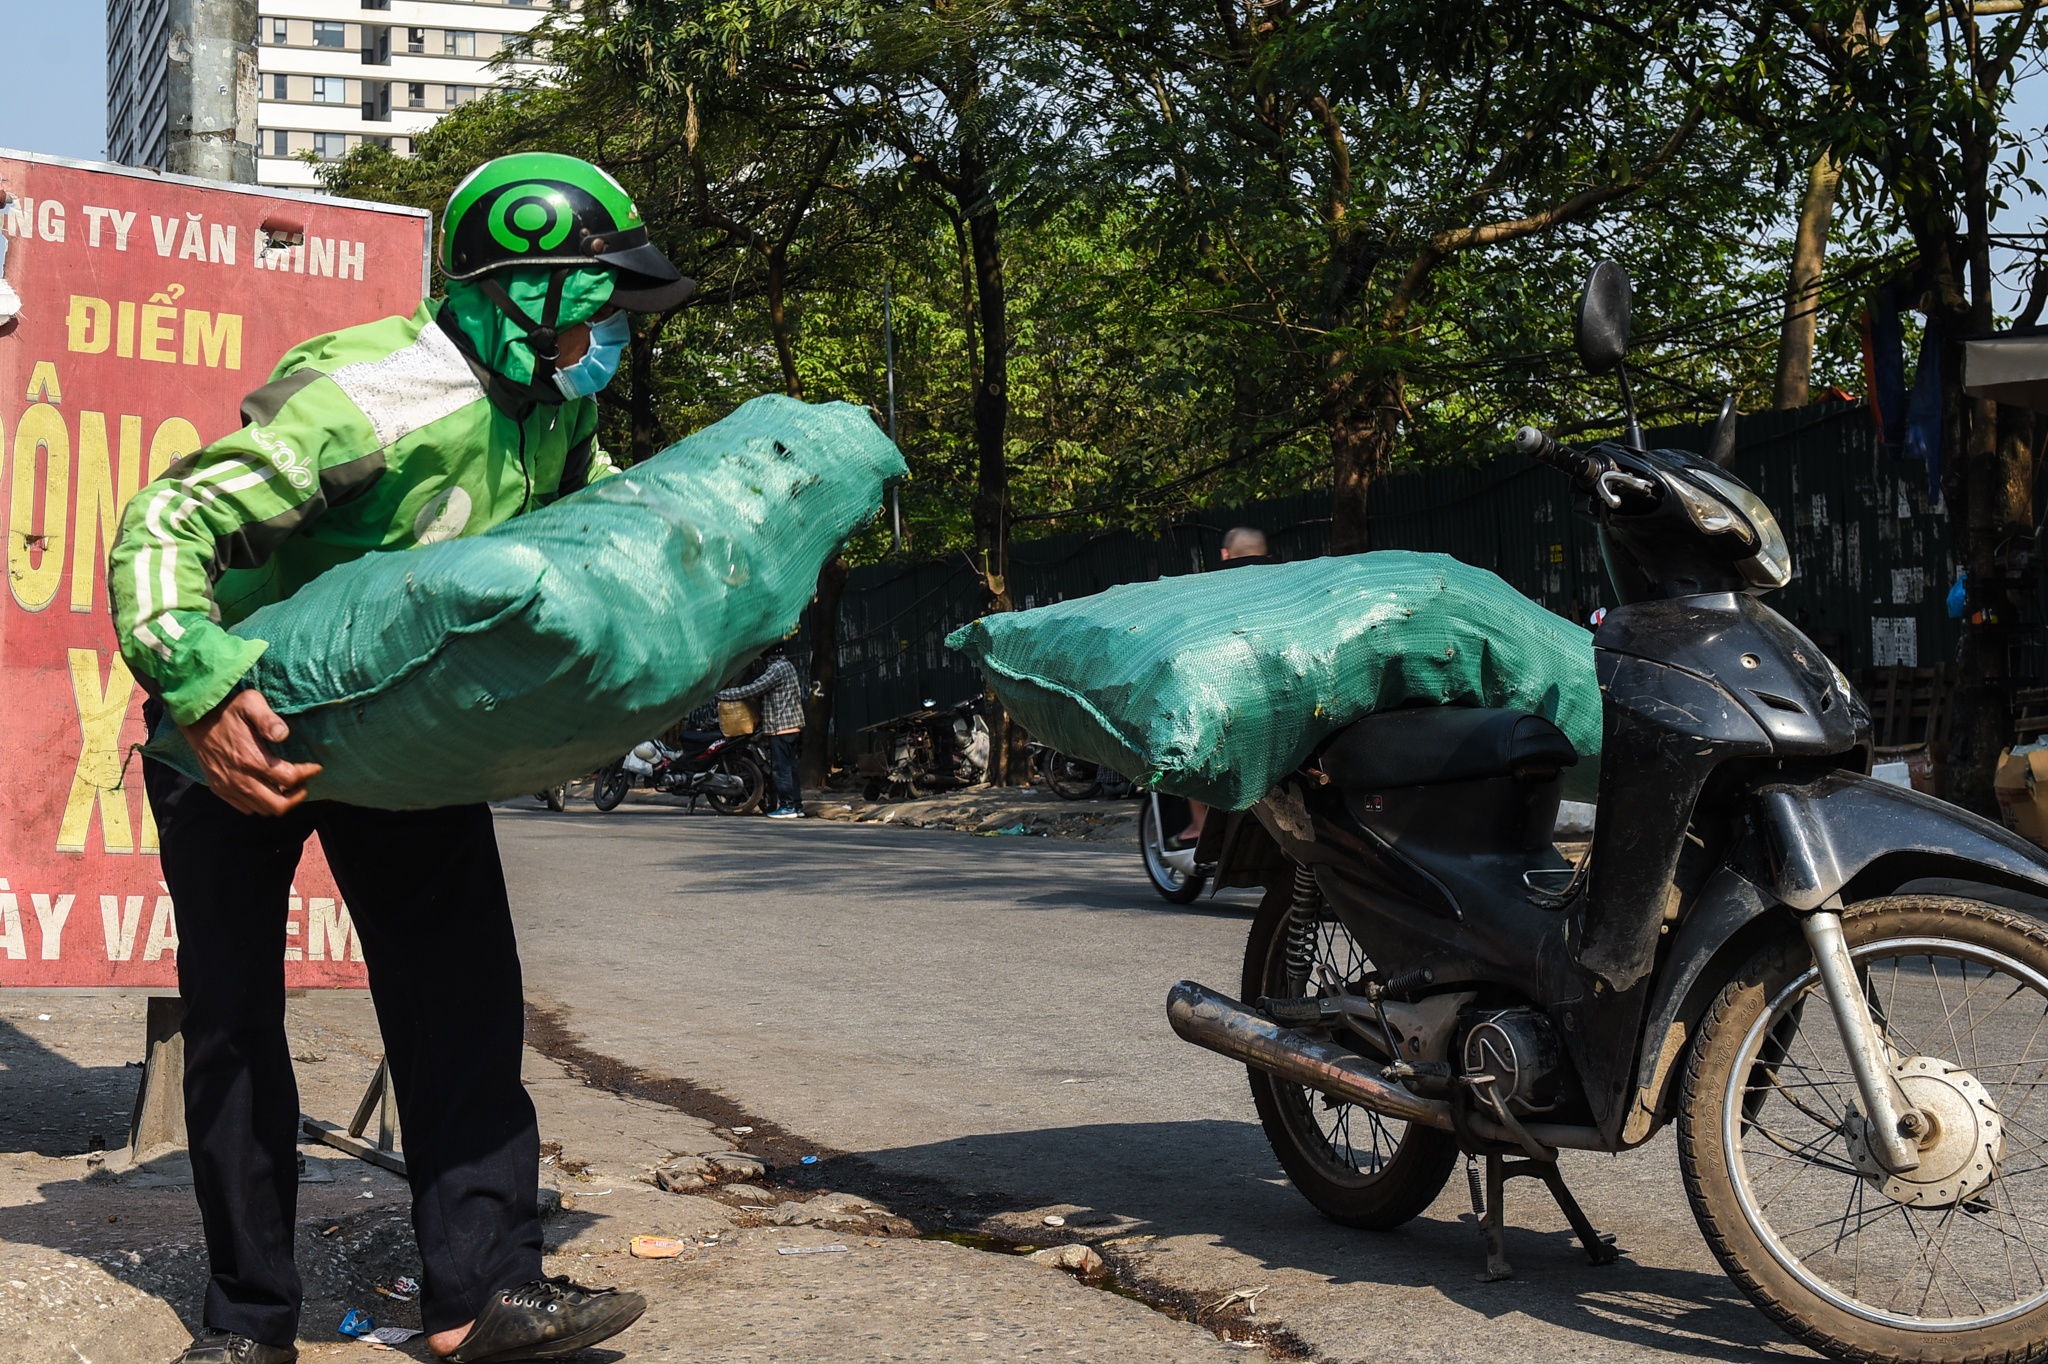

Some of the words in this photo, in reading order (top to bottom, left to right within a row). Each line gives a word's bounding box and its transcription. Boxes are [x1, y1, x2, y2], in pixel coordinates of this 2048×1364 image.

[0, 197, 65, 243] NG
[83, 205, 137, 252] TY
[151, 212, 237, 265] VĂN
[66, 283, 242, 370] ĐIỂM
[56, 647, 160, 855] X
[99, 880, 179, 961] VÀ
[1705, 1104, 1721, 1170] 70/100
